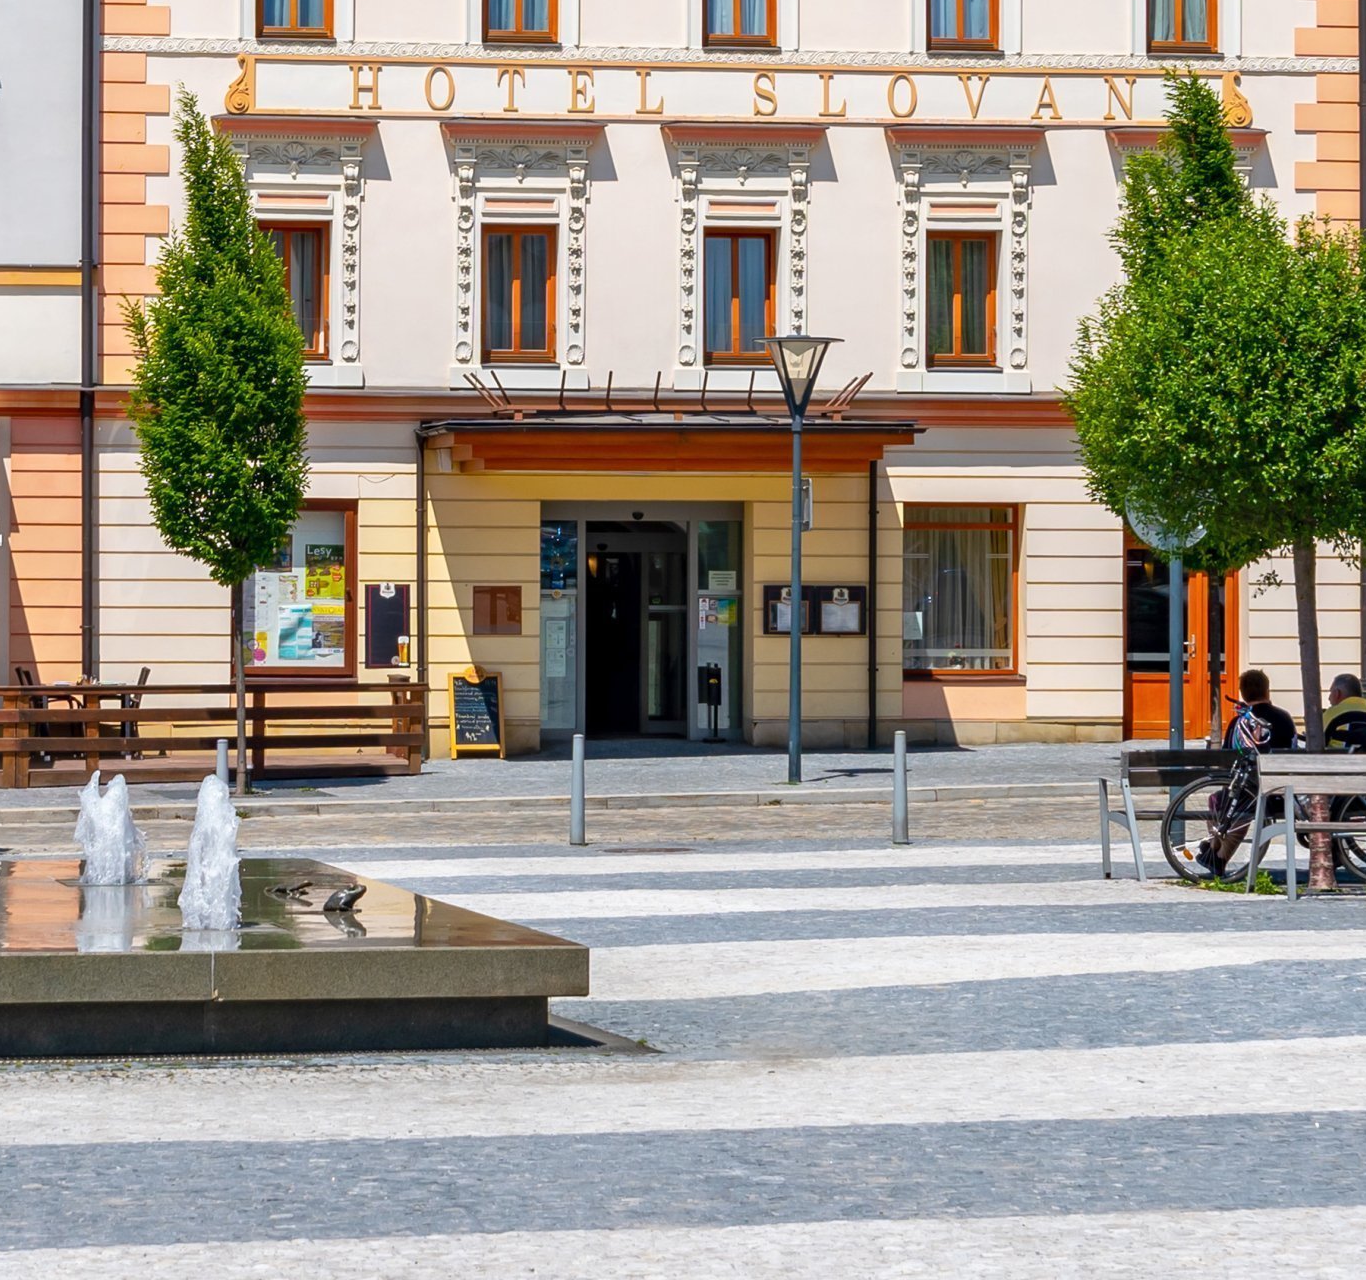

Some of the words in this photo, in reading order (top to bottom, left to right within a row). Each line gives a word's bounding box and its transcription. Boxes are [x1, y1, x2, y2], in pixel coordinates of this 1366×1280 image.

[348, 63, 664, 114] HOTEL
[752, 71, 1136, 121] SLOVAN
[307, 545, 332, 558] Lesy
